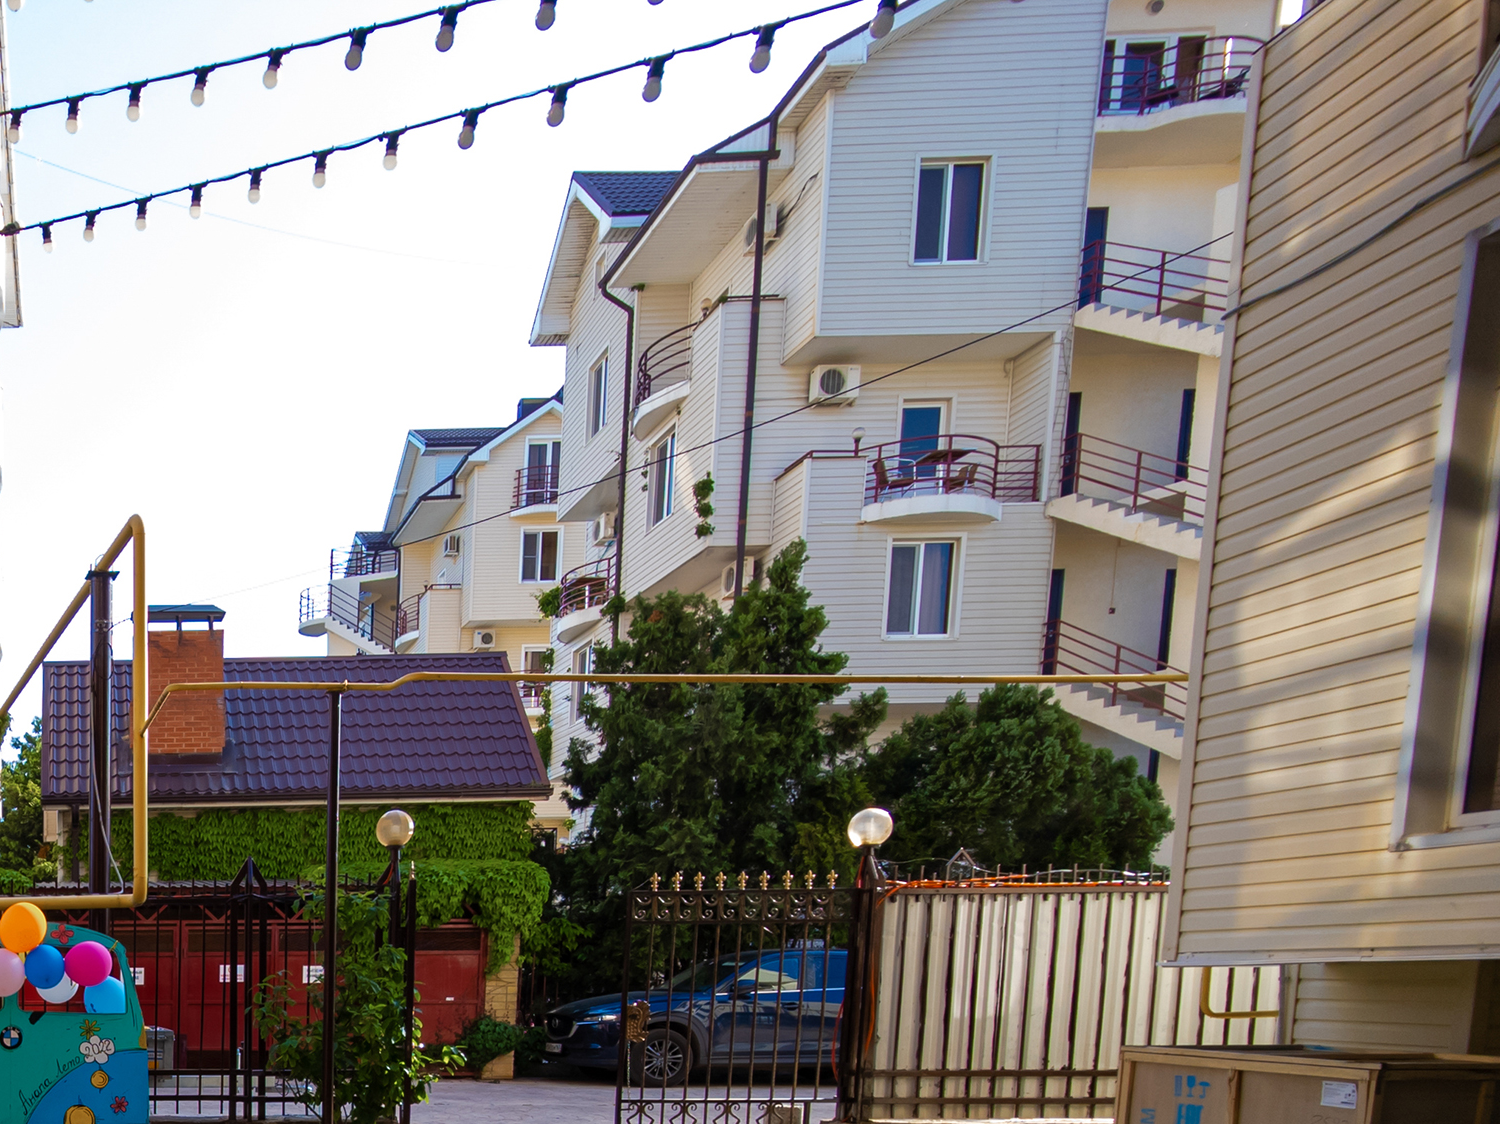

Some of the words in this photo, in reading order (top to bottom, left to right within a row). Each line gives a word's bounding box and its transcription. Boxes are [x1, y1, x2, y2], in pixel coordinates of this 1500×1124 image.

[84, 1040, 112, 1057] 2022
[19, 1078, 52, 1116] Анапа
[56, 1055, 81, 1078] Лето
